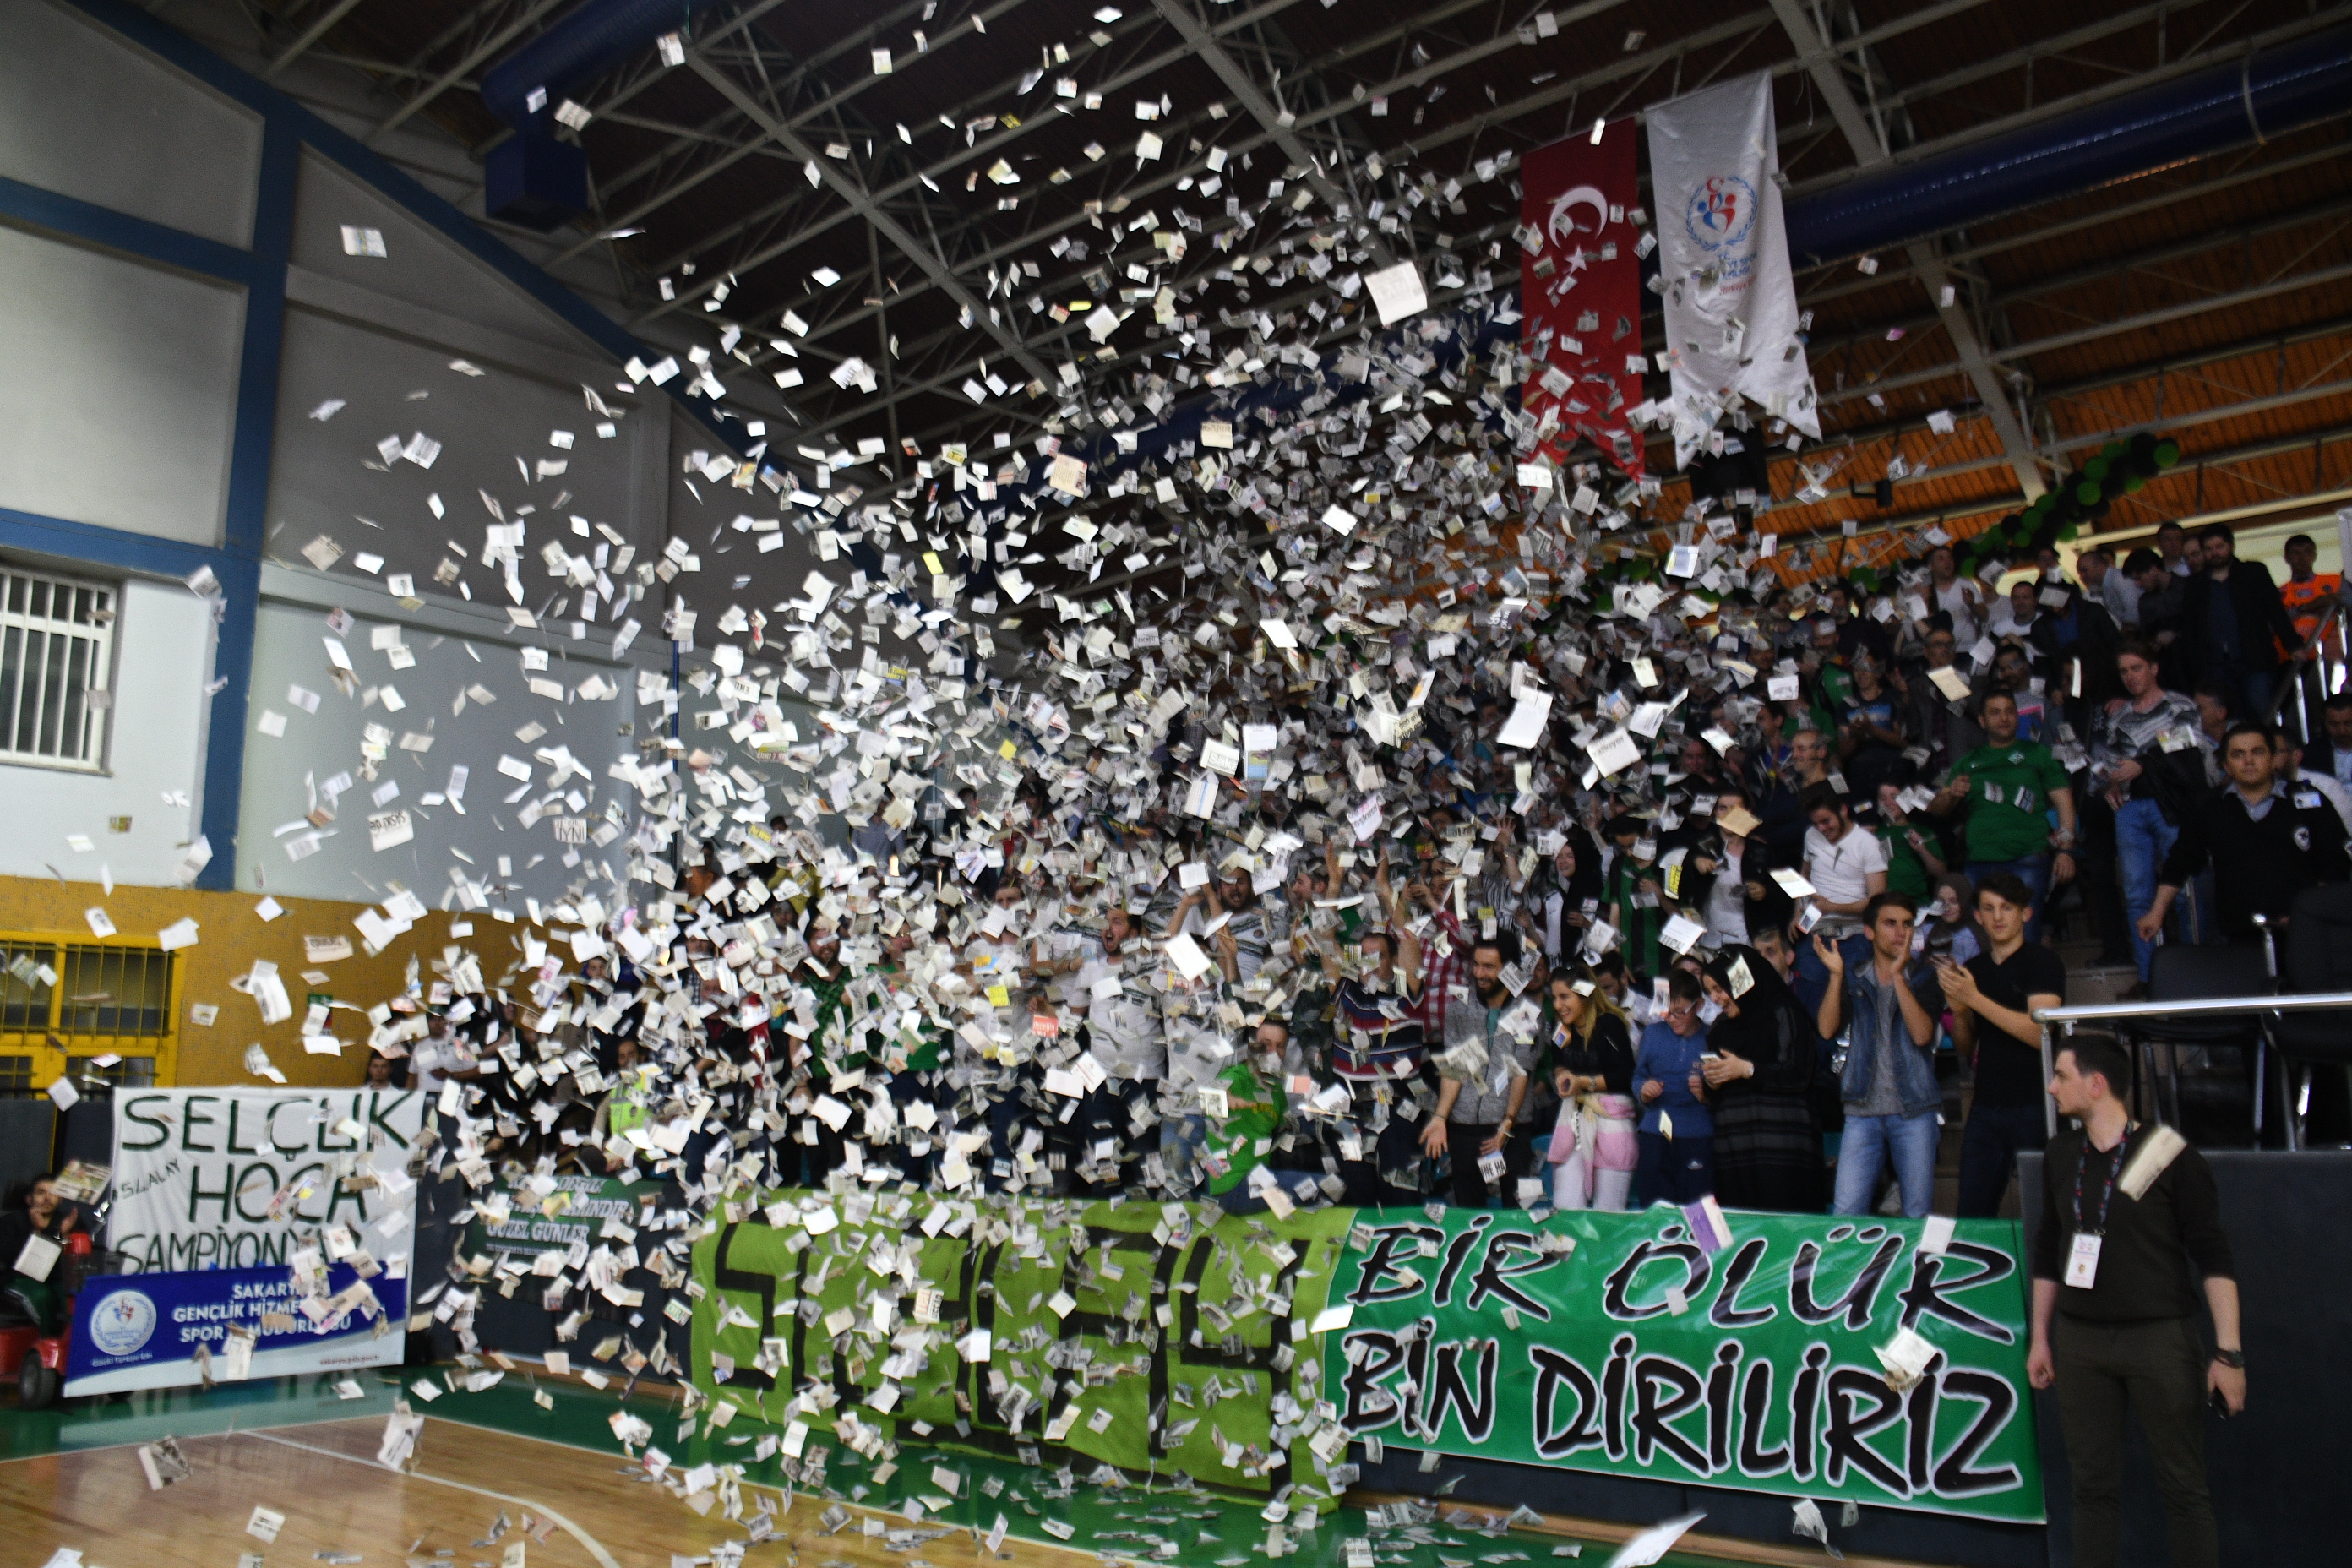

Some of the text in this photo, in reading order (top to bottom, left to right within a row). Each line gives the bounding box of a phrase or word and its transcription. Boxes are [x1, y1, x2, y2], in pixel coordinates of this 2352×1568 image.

[122, 1091, 416, 1162] SELÇUK
[188, 1162, 368, 1224] HOCA
[172, 1299, 244, 1324] GENÇLİK
[1346, 1215, 2016, 1346] BİR ÖLÜR
[180, 1326, 224, 1343] SPOR
[1337, 1315, 2023, 1501] BİN DİRİLİRİZ
